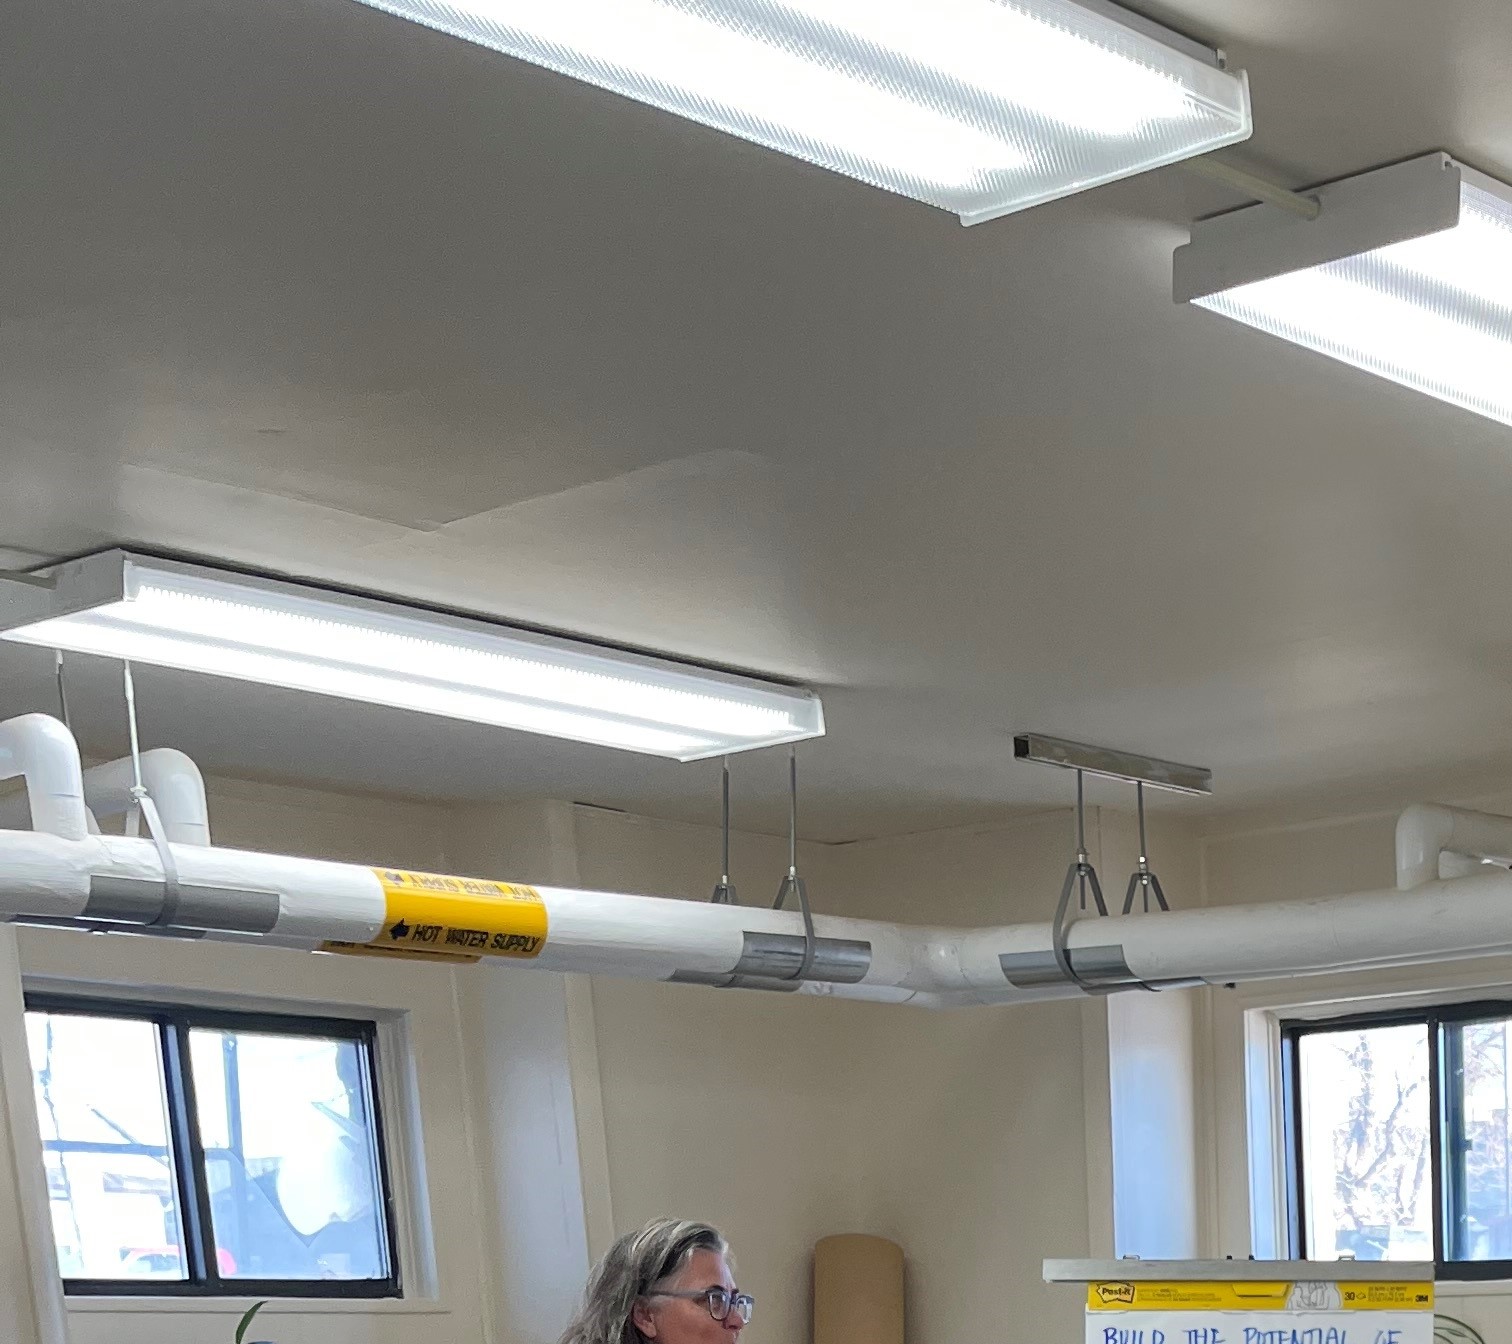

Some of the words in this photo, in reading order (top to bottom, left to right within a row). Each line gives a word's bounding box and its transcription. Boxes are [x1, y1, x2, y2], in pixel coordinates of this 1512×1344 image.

[412, 924, 443, 941] HOT
[445, 928, 489, 948] WATER
[491, 933, 540, 952] SUPPLY
[1102, 1287, 1131, 1296] Post-it
